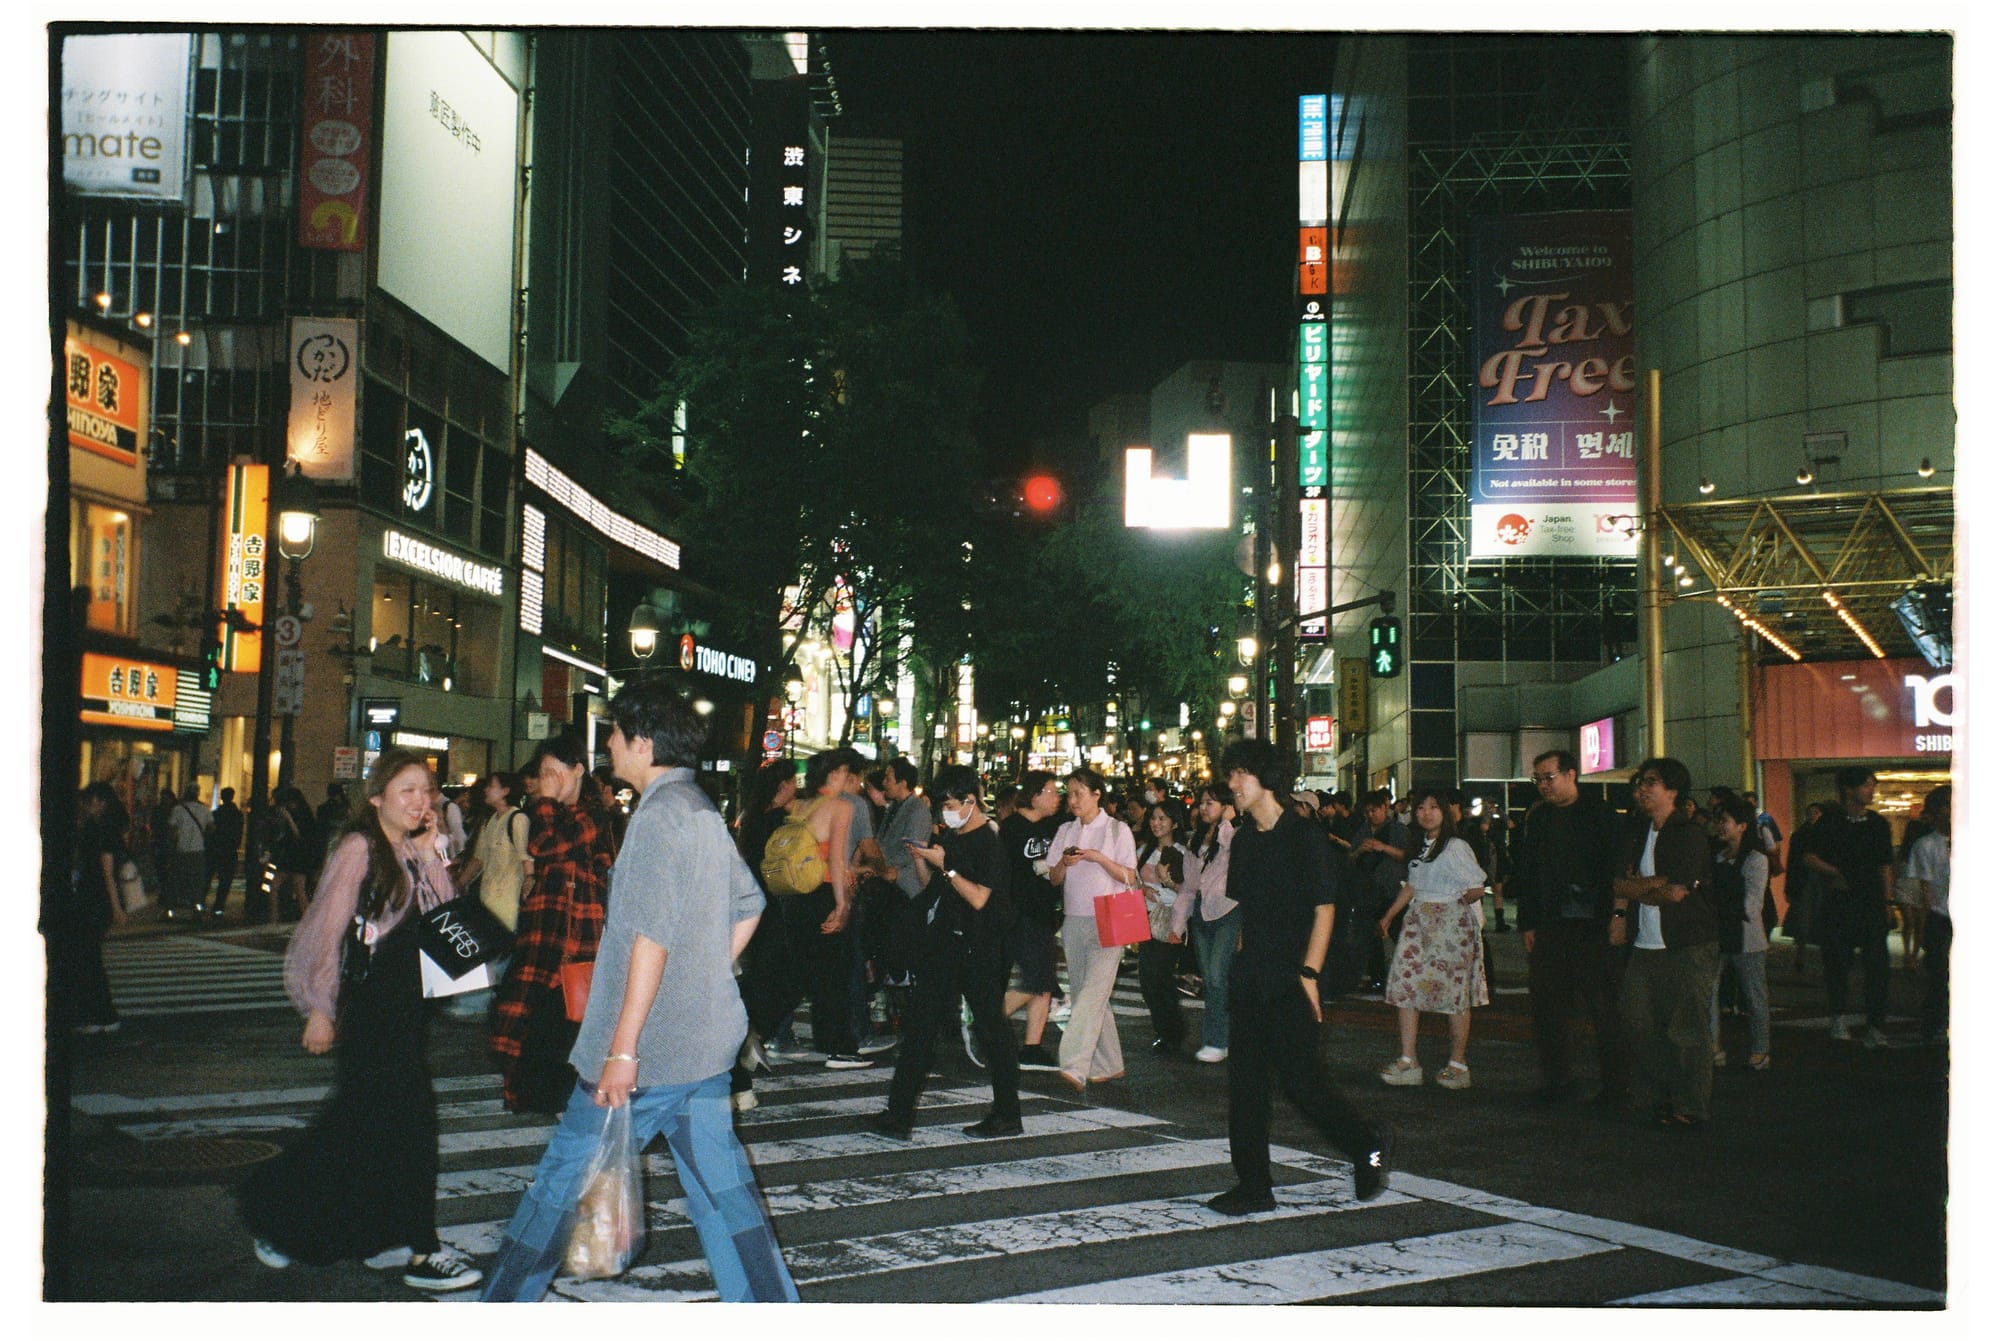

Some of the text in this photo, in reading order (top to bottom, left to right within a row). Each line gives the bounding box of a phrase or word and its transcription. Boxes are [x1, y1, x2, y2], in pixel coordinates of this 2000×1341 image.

[63, 130, 162, 160] mate
[1303, 97, 1323, 158] THE PRIME
[783, 147, 804, 285] 渋東シネ
[1511, 257, 1612, 271] SHIBUYA109
[1519, 246, 1589, 257] Welcome
[1504, 292, 1633, 348] Tax
[68, 352, 120, 413] 野家
[311, 334, 336, 383] つかだ
[1479, 347, 1634, 406] Free
[1490, 479, 1509, 488] Not
[1511, 476, 1557, 487] available
[1574, 479, 1602, 487] some
[384, 530, 463, 580] EXCELSIOR
[1551, 533, 1575, 543] Shop
[242, 535, 265, 603] 吉野家
[281, 620, 293, 641] 3
[109, 664, 159, 701] 吉野家
[696, 645, 727, 676] TOHO
[431, 911, 480, 959] NARS
